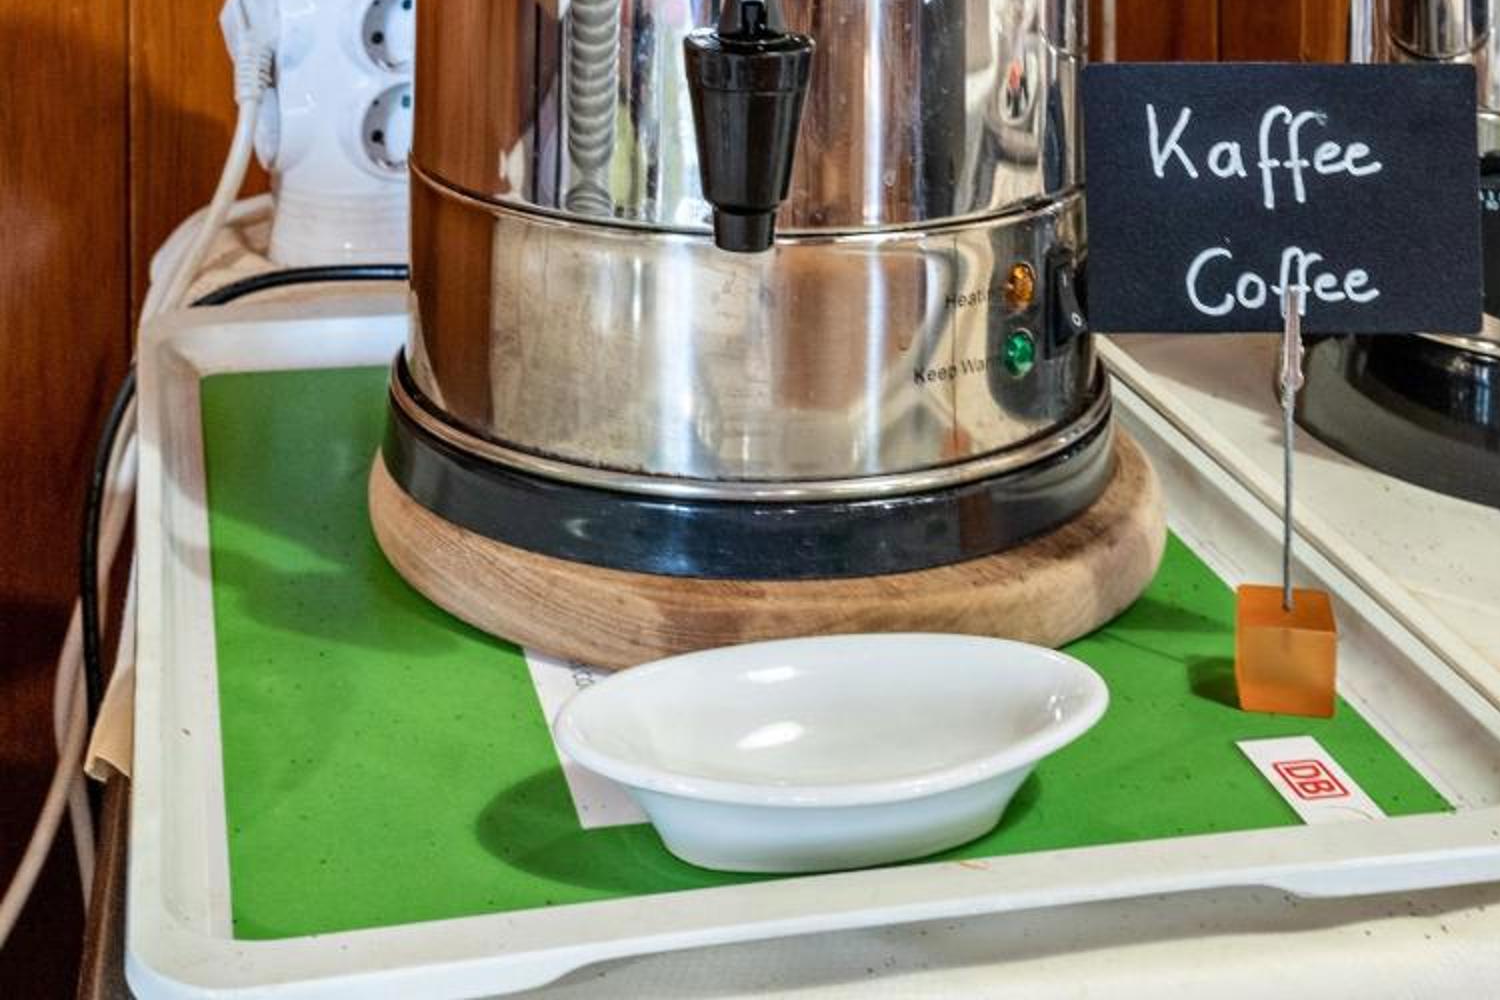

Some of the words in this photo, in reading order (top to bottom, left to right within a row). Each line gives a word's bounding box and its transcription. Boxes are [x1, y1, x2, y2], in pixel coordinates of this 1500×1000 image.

[1145, 103, 1383, 211] Kaffee
[1186, 245, 1381, 318] Coffee
[1281, 763, 1337, 796] DB
